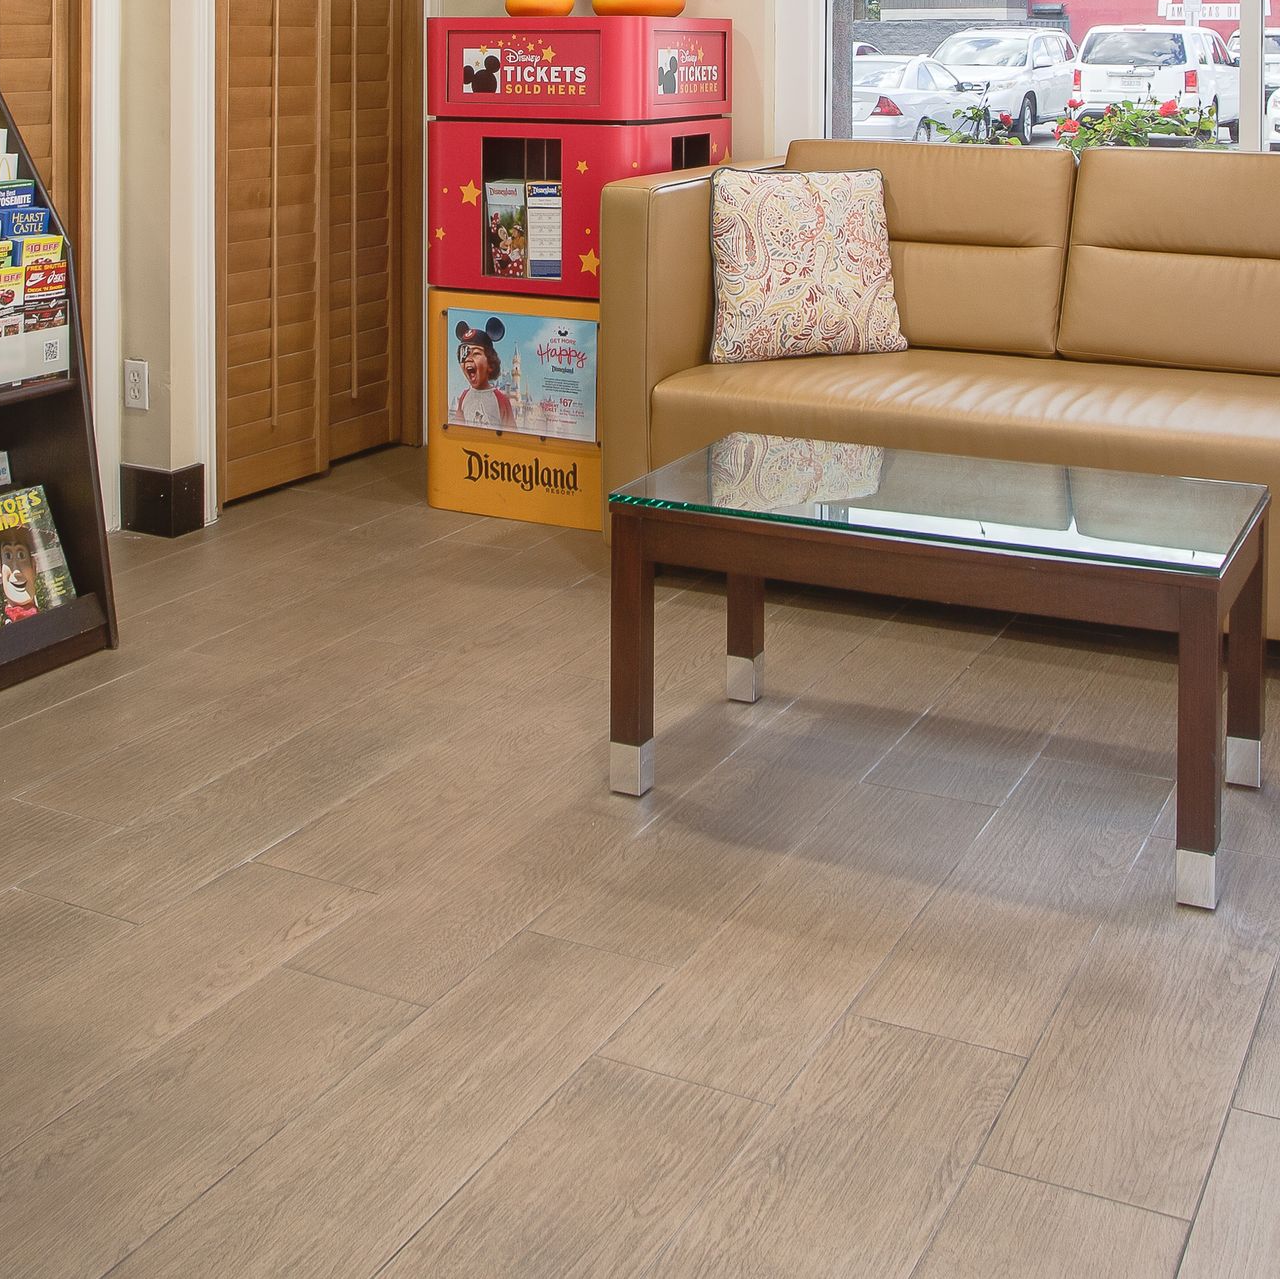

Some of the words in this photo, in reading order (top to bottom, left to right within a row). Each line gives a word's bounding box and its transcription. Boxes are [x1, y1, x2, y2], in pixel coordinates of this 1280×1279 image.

[504, 48, 541, 67] Disney
[504, 66, 586, 82] TICKETS
[680, 66, 718, 82] TICKETS
[505, 84, 541, 94] SOLD
[547, 84, 586, 95] HERE
[680, 84, 698, 94] SOLD
[699, 83, 718, 94] HERE
[11, 212, 45, 224] HEARST
[13, 222, 43, 235] CASTLE
[42, 242, 60, 252] OFF
[26, 264, 43, 272] FREE
[2, 273, 21, 283] OFF
[537, 343, 587, 368] Happy
[462, 447, 580, 492] Disneyland
